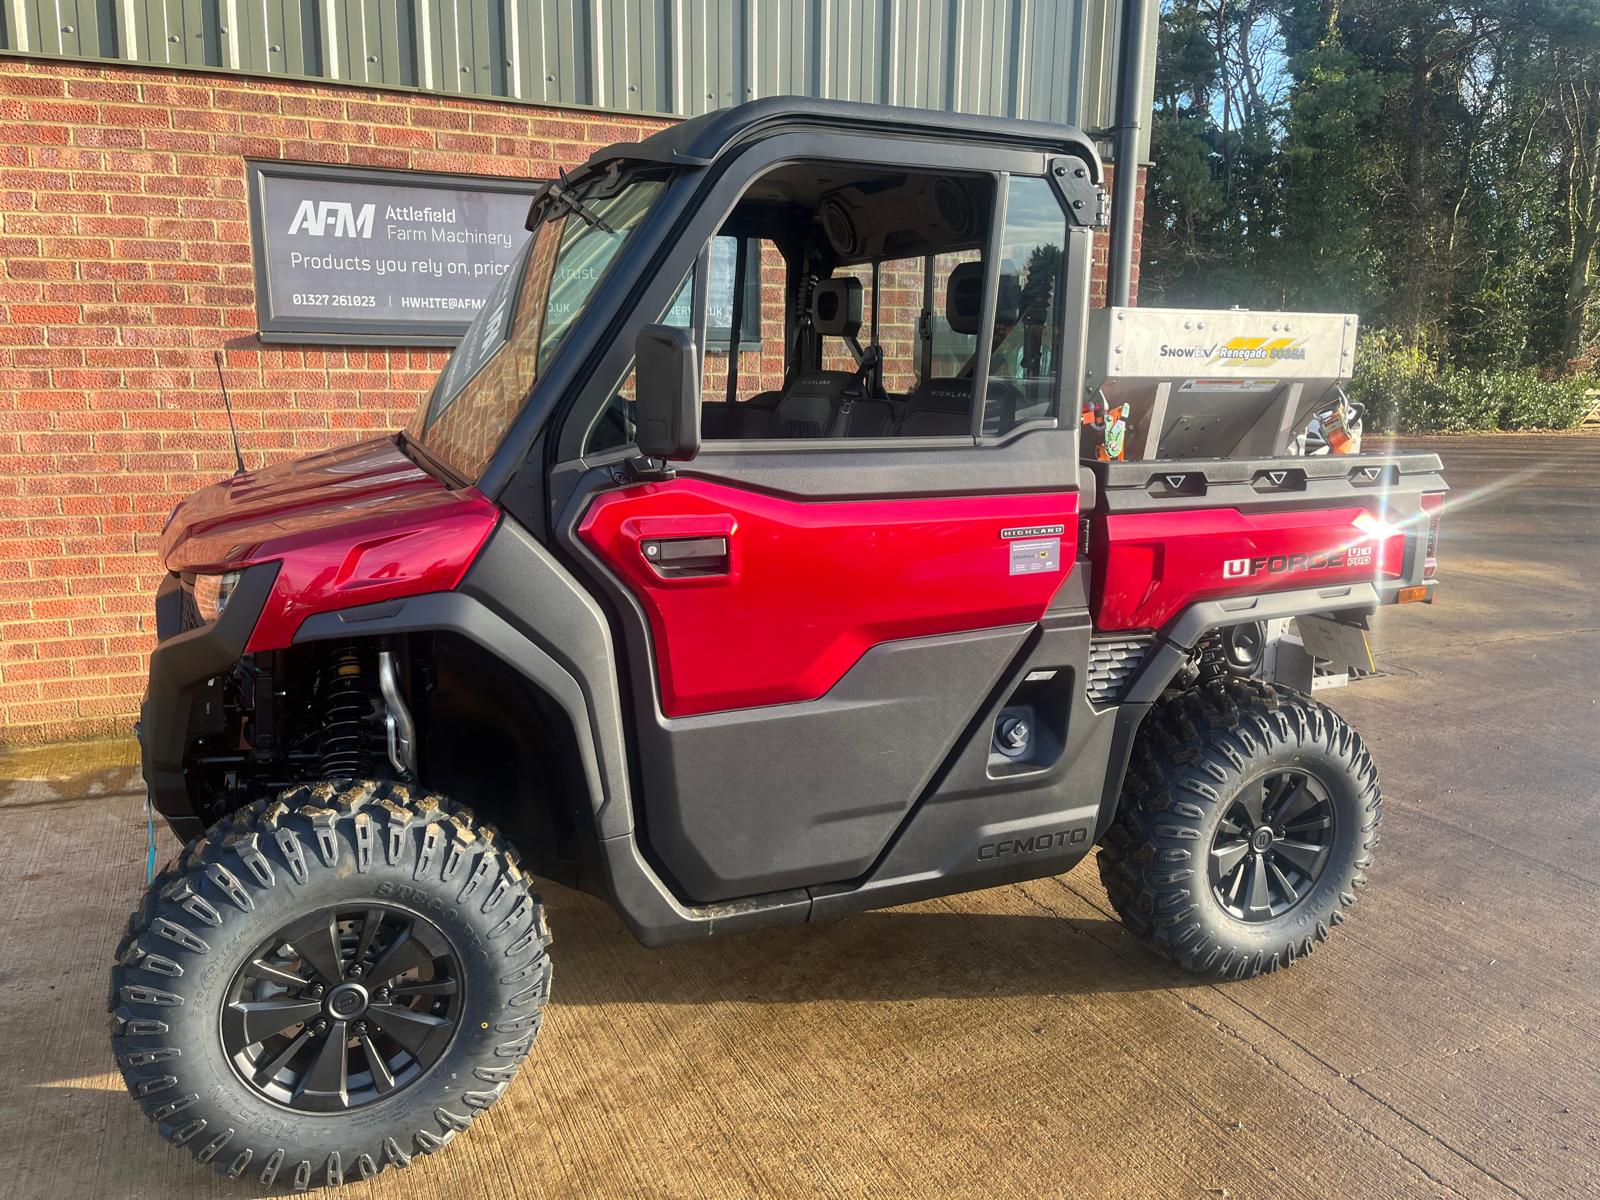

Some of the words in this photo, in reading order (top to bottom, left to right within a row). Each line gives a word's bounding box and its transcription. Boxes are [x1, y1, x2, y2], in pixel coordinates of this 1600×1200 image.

[287, 199, 376, 239] AFM
[385, 204, 456, 224] Attlefield
[387, 224, 427, 242] Farm
[431, 227, 512, 249] Machinery
[291, 251, 371, 272] Products
[375, 259, 407, 275] you
[412, 257, 443, 278] rely
[447, 261, 471, 277] on,
[292, 293, 329, 306] 01327
[332, 295, 376, 307] 261023
[1218, 346, 1268, 361] Renegade
[1003, 527, 1062, 537] HIGHLAND
[1346, 555, 1372, 567] PRO
[976, 827, 1088, 862] CFMOTO
